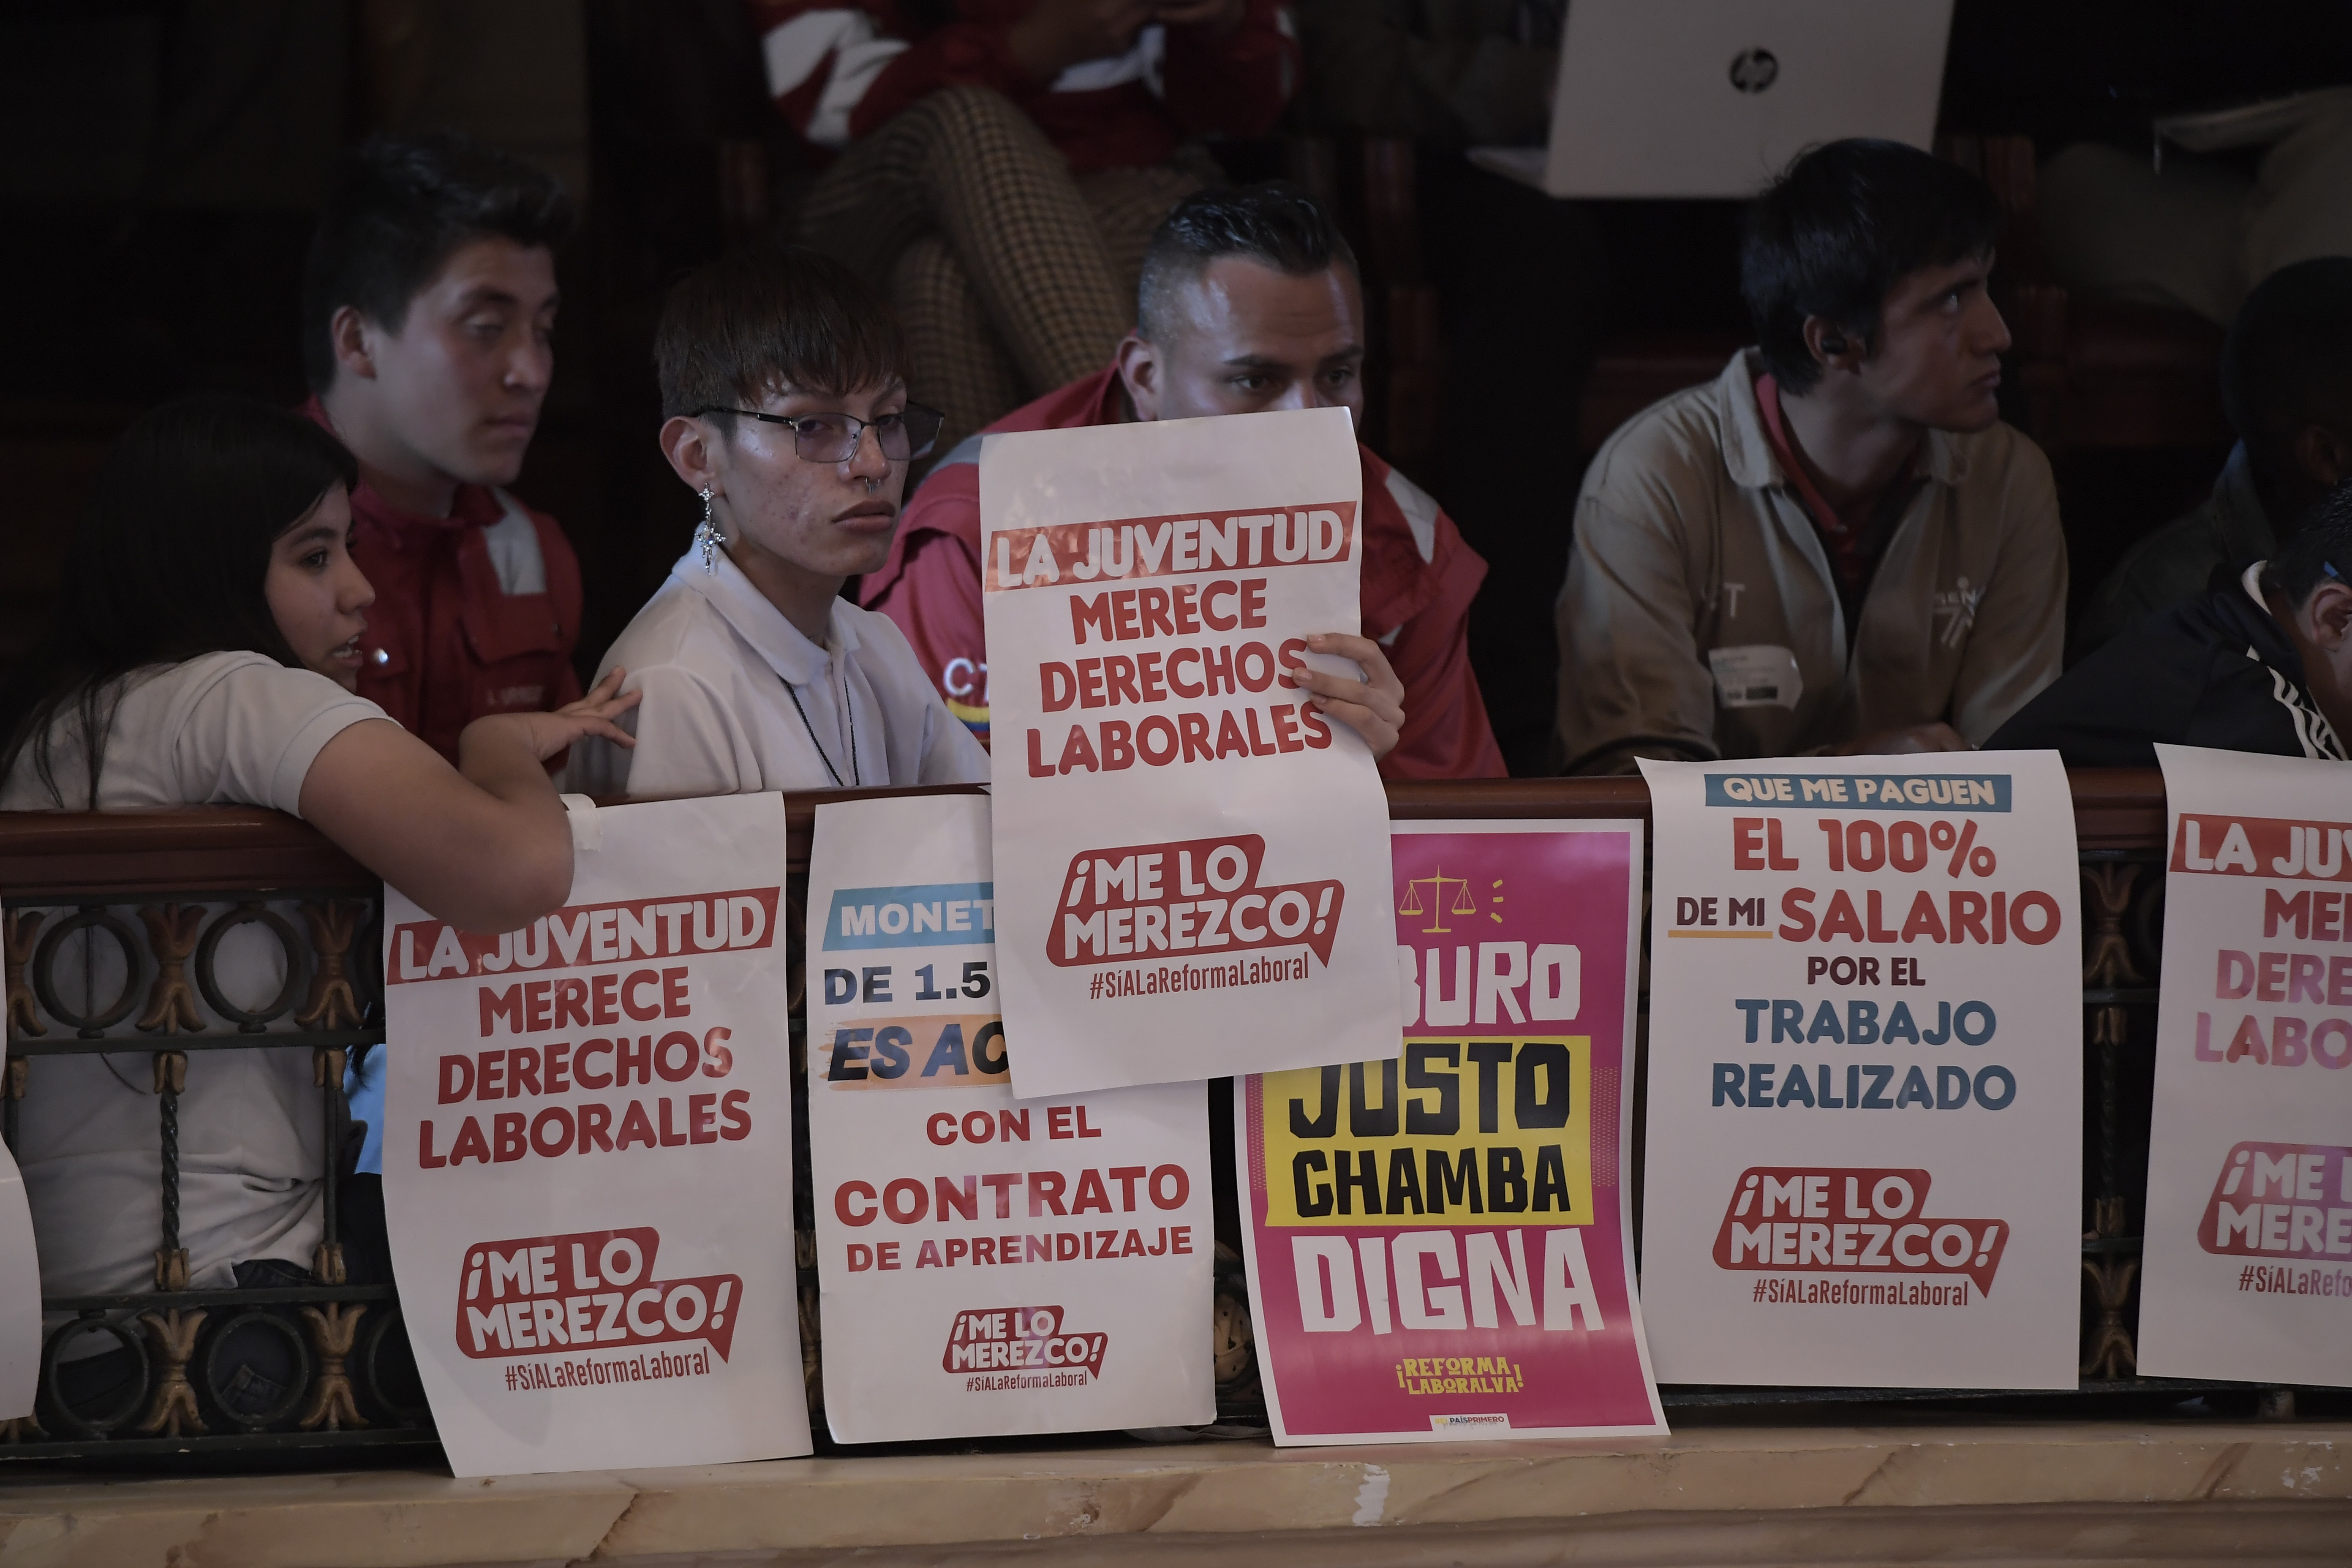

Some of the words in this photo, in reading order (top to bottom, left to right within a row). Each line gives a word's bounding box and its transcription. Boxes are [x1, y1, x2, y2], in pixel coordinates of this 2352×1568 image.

[997, 534, 1060, 587] LA
[1073, 509, 1343, 579] JUVENTUD
[1070, 578, 1267, 645] MERECE
[1040, 638, 1307, 713] DERECHOS
[1026, 701, 1332, 778] LABORALES
[1723, 778, 1794, 802] QUE
[1799, 778, 1849, 803] ME
[1856, 778, 1996, 806] PAGUEN
[1067, 853, 1163, 907] ¡ME
[1179, 845, 1249, 896] LO
[1733, 817, 1799, 871] EL
[1818, 819, 1996, 879] 100%
[2185, 820, 2257, 874] LA
[2272, 826, 2352, 878] JU
[400, 925, 470, 980] LA
[482, 896, 766, 972] JUVENTUD
[1064, 887, 1334, 960] MEREZCO!
[1676, 896, 1718, 926] DE
[1728, 897, 1765, 926] MI
[1778, 887, 2061, 945] SALARIO
[2263, 888, 2352, 943] ME
[825, 966, 893, 1005] DE
[915, 961, 991, 1002] 1.5
[1090, 952, 1309, 1000] #SíALaReformaLaboral
[1807, 956, 1880, 985] POR
[1891, 957, 1926, 986] EL
[2216, 949, 2352, 1007] DERE
[479, 966, 691, 1037] MERECE
[1735, 999, 1996, 1046] TRABAJO
[438, 1027, 732, 1105] DERECHOS
[828, 1026, 912, 1082] ES
[2195, 1012, 2352, 1070] LABO
[1289, 1043, 1570, 1138] JUSTO
[1712, 1062, 2017, 1111] REALIZADO
[419, 1089, 752, 1169] LABORALES
[926, 1108, 1031, 1146] CON
[1047, 1105, 1102, 1140] EL
[834, 1164, 1190, 1227] CONTRATO
[1292, 1144, 1571, 1218] CHAMBA
[1734, 1174, 1830, 1219] ¡ME
[1845, 1176, 1914, 1220] LO
[2221, 1150, 2325, 1200] ¡ME
[847, 1241, 901, 1272] DE
[915, 1226, 1193, 1269] APRENDIZAJE
[1730, 1222, 1999, 1267] MEREZCO!
[2216, 1201, 2352, 1254] MERE
[466, 1245, 559, 1300] ¡ME
[572, 1237, 643, 1290] LO
[1291, 1227, 1605, 1335] DIGNA
[1753, 1279, 1968, 1307] #SíALaReformaLaboral
[466, 1282, 732, 1352] MEREZCO!
[954, 1313, 1007, 1341] ¡ME
[1015, 1310, 1055, 1339] LO
[505, 1347, 710, 1391] #SíALaReformaLaboral
[953, 1335, 1102, 1370] MEREZCO!
